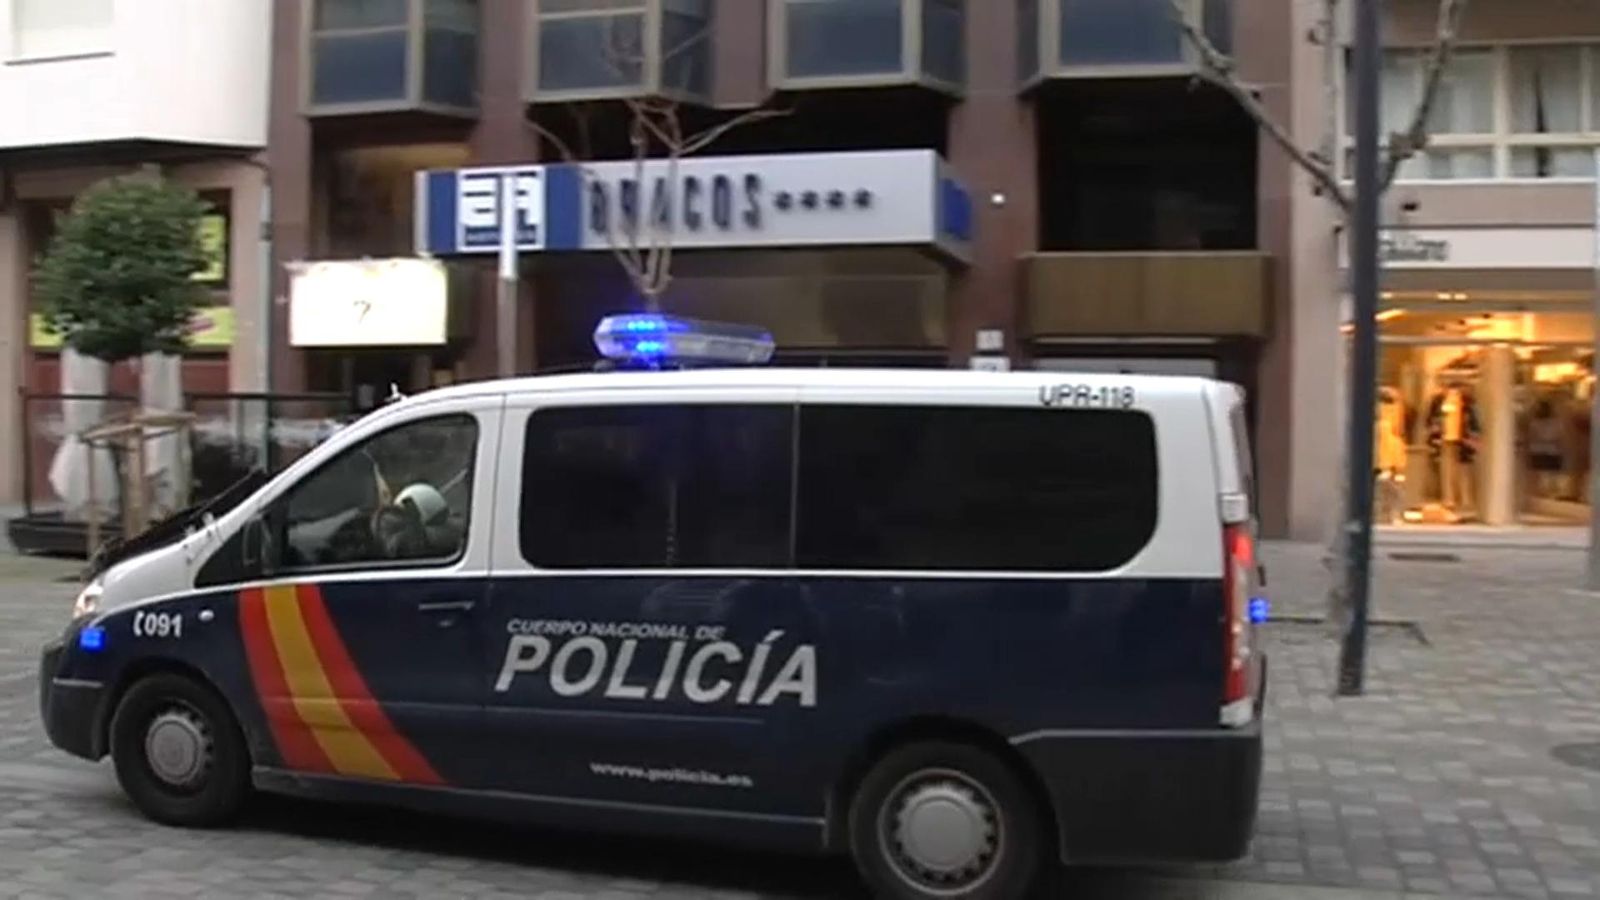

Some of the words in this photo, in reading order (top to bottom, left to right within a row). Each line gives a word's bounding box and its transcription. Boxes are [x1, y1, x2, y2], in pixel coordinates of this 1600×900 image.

[143, 611, 182, 638] 091
[505, 617, 587, 636] CUERPO
[588, 620, 689, 640] NACIONAL
[694, 624, 727, 641] DE
[494, 629, 818, 707] POLICÍA
[589, 761, 754, 788] www.policia.es
